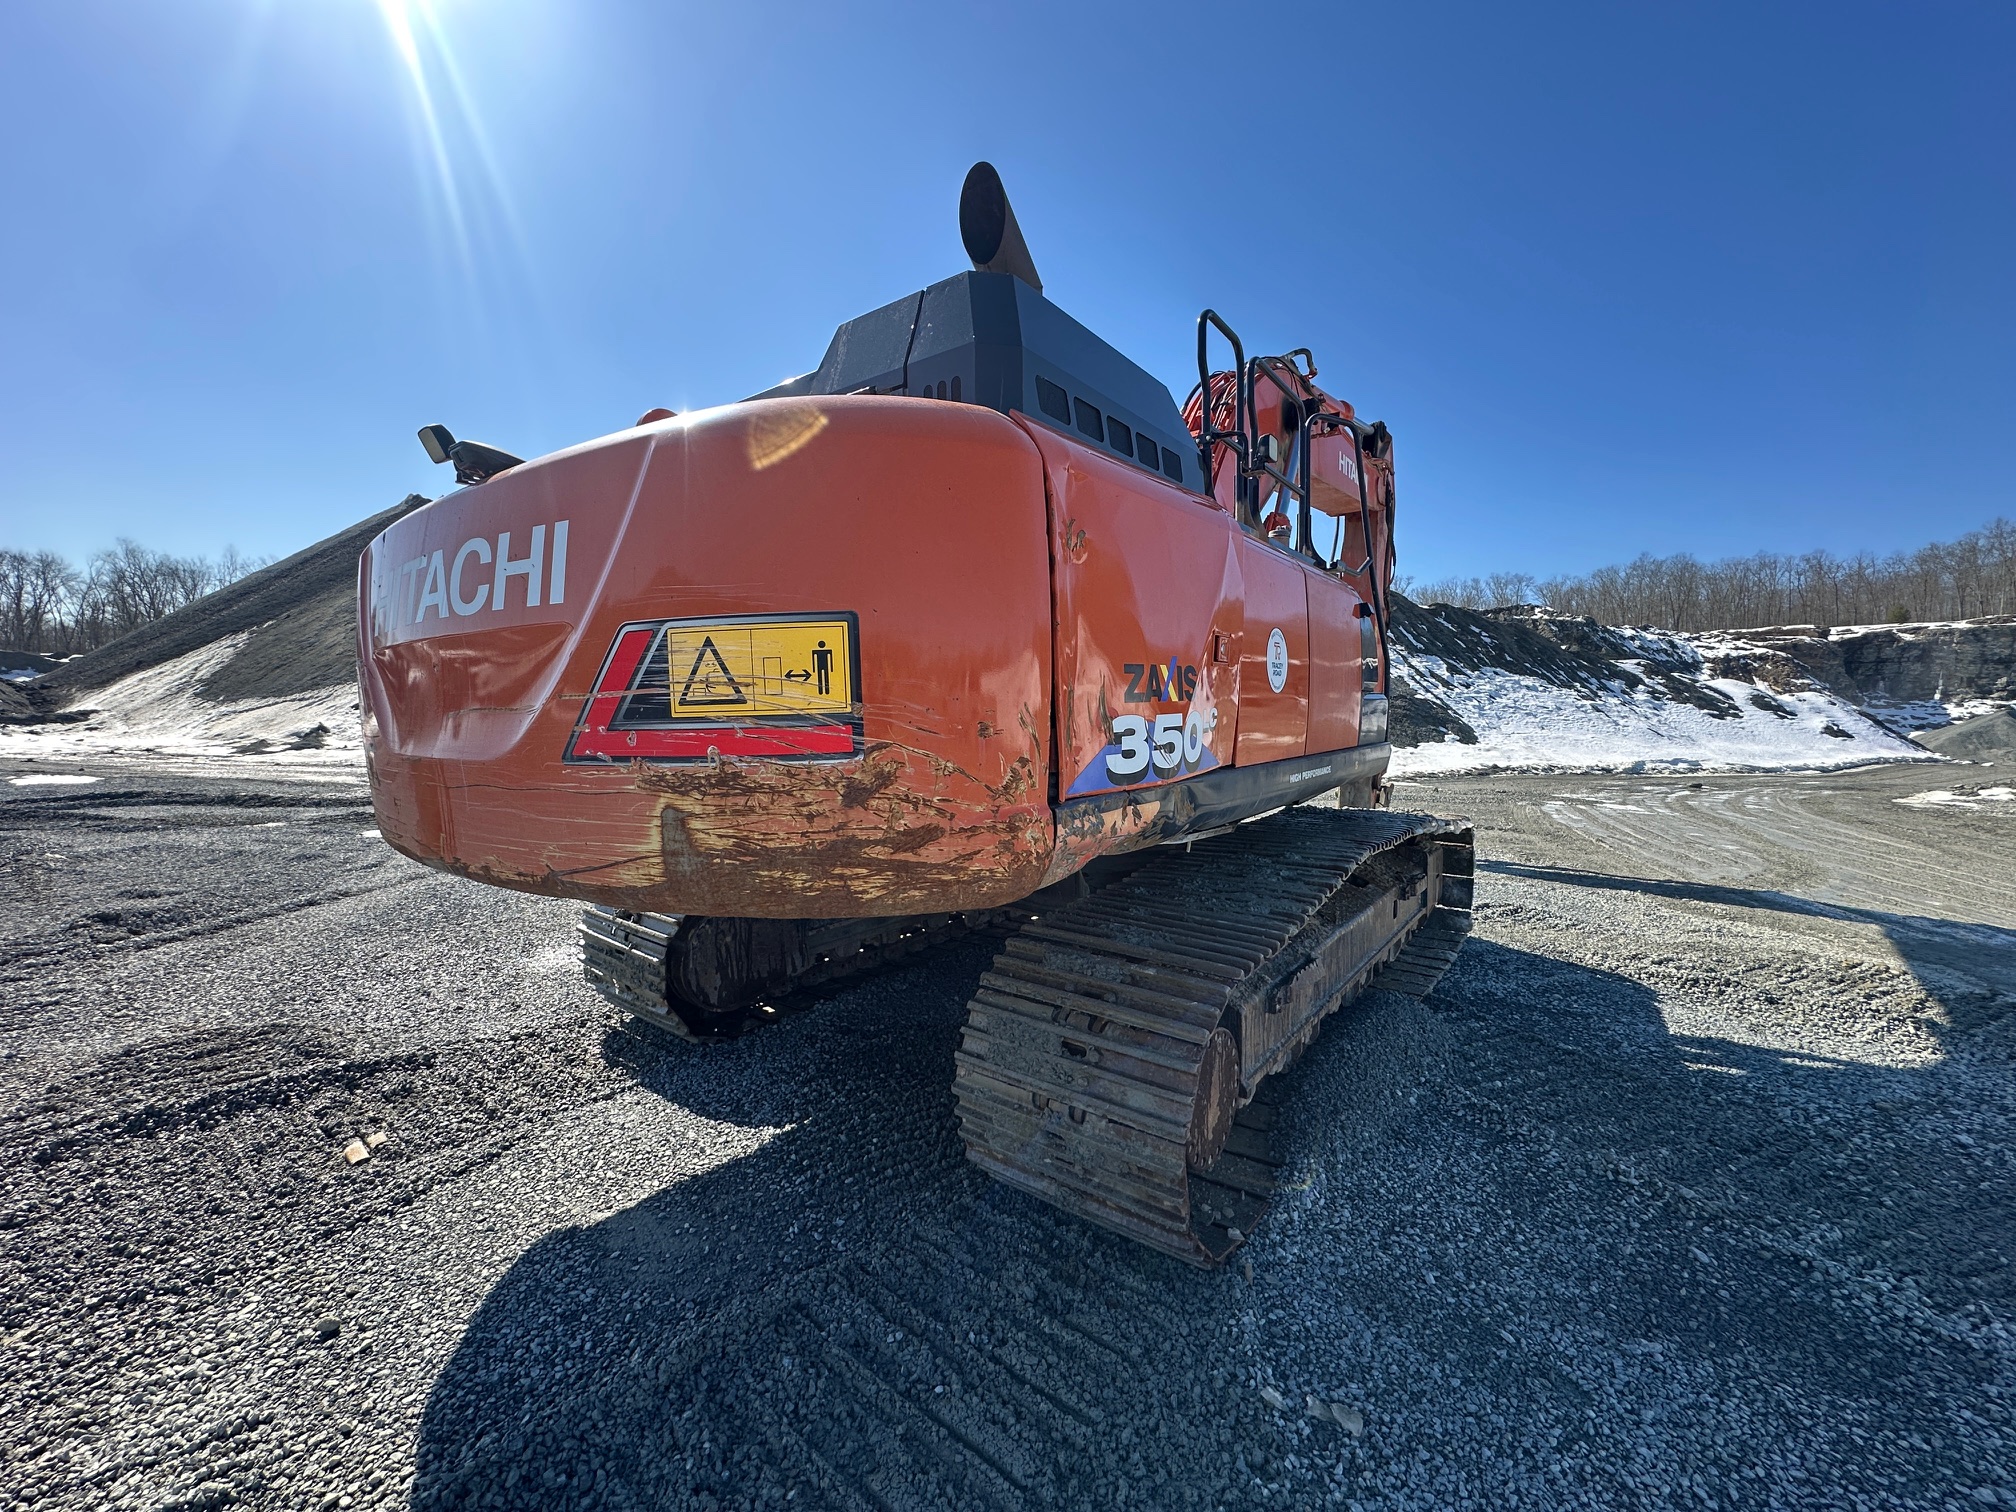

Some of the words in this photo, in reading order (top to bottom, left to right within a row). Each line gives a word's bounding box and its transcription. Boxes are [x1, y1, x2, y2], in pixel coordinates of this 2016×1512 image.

[375, 519, 569, 637] HITACHI
[1123, 656, 1198, 703] ZAXIS
[1289, 772, 1301, 784] HIGH
[1302, 765, 1332, 781] PERFORMANCE
